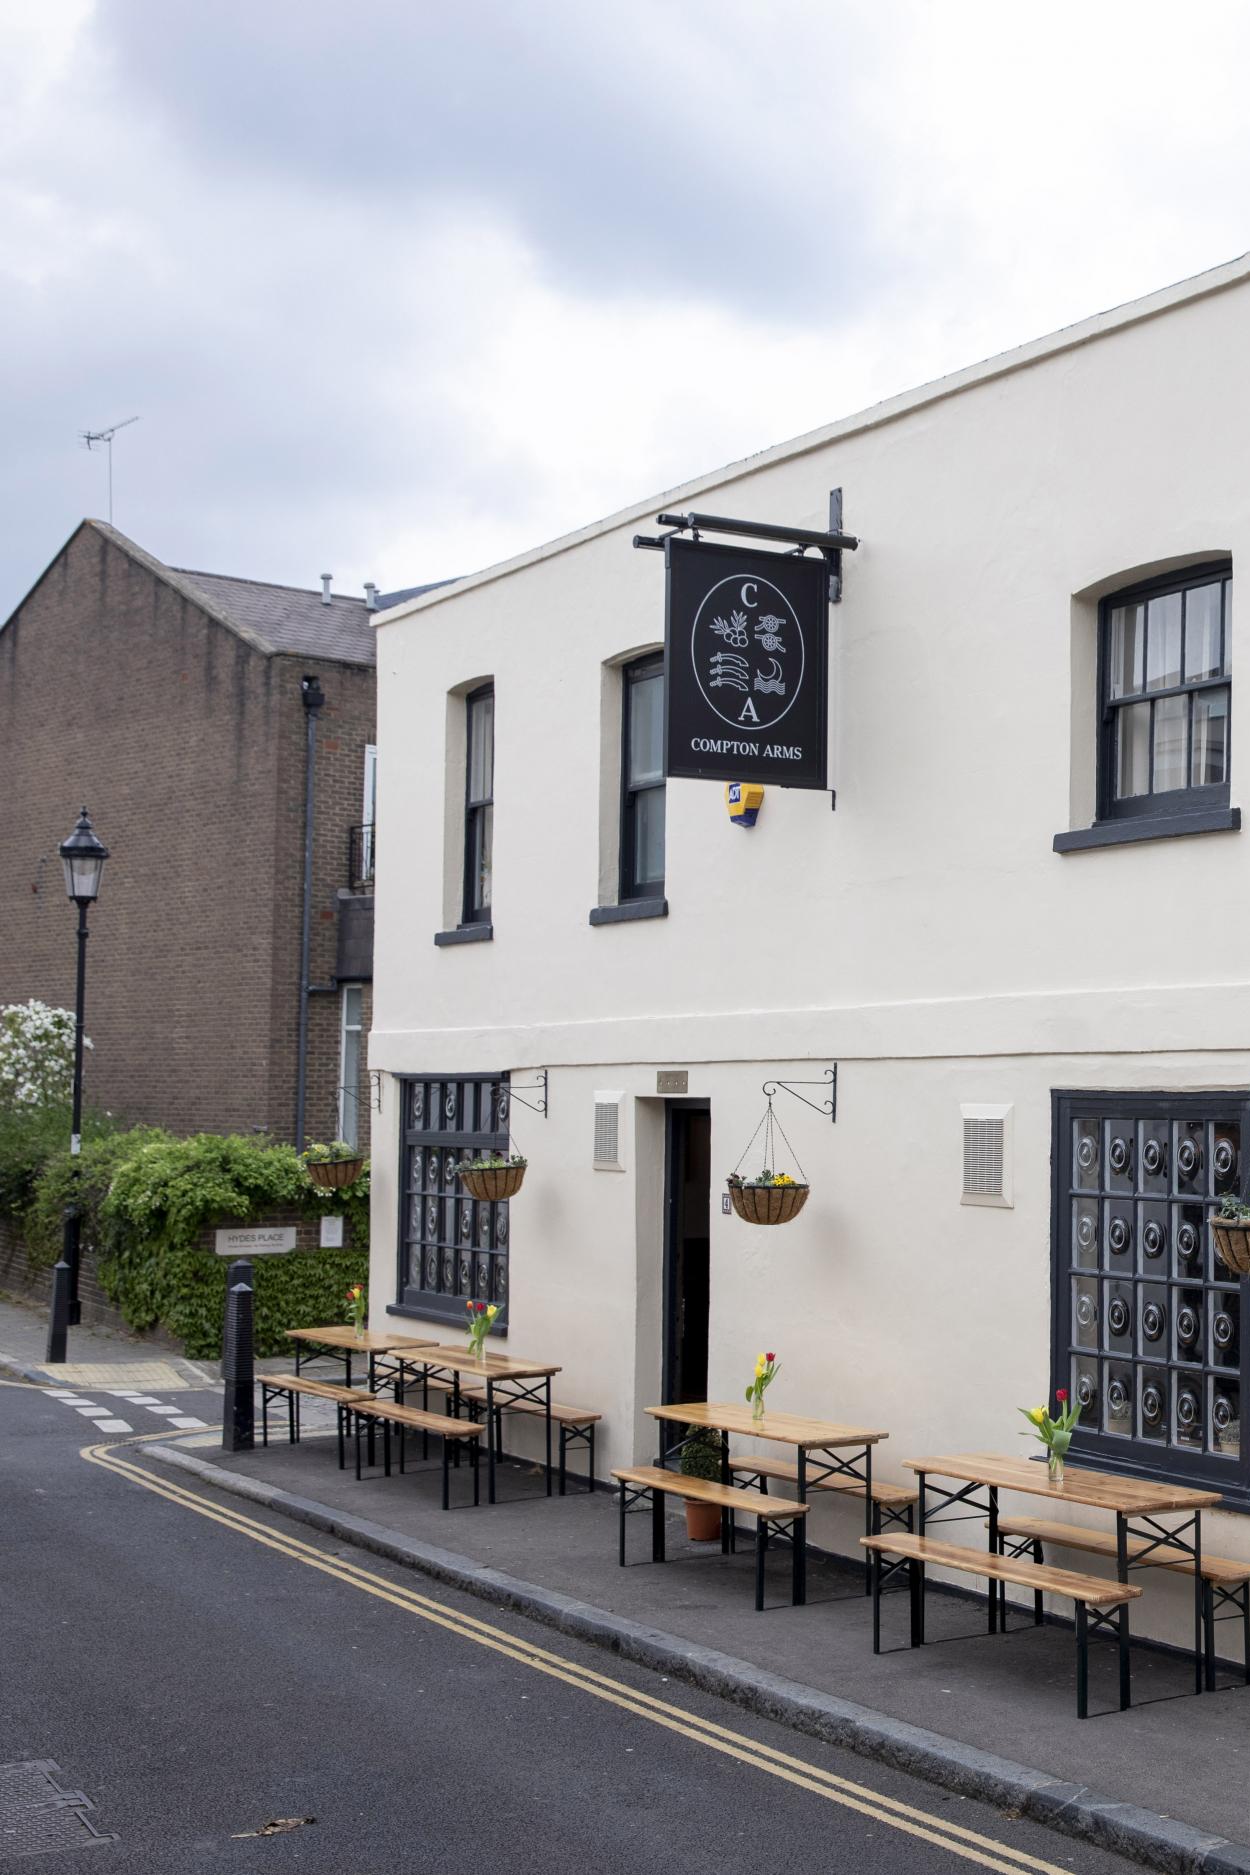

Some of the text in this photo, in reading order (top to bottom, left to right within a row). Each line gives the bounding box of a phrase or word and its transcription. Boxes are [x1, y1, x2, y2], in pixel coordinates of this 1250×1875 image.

[740, 582, 758, 608] C
[738, 697, 760, 722] A
[690, 737, 802, 760] COMPTON ARMS
[729, 786, 741, 800] ADT
[228, 1233, 285, 1243] HYDES PLACE
